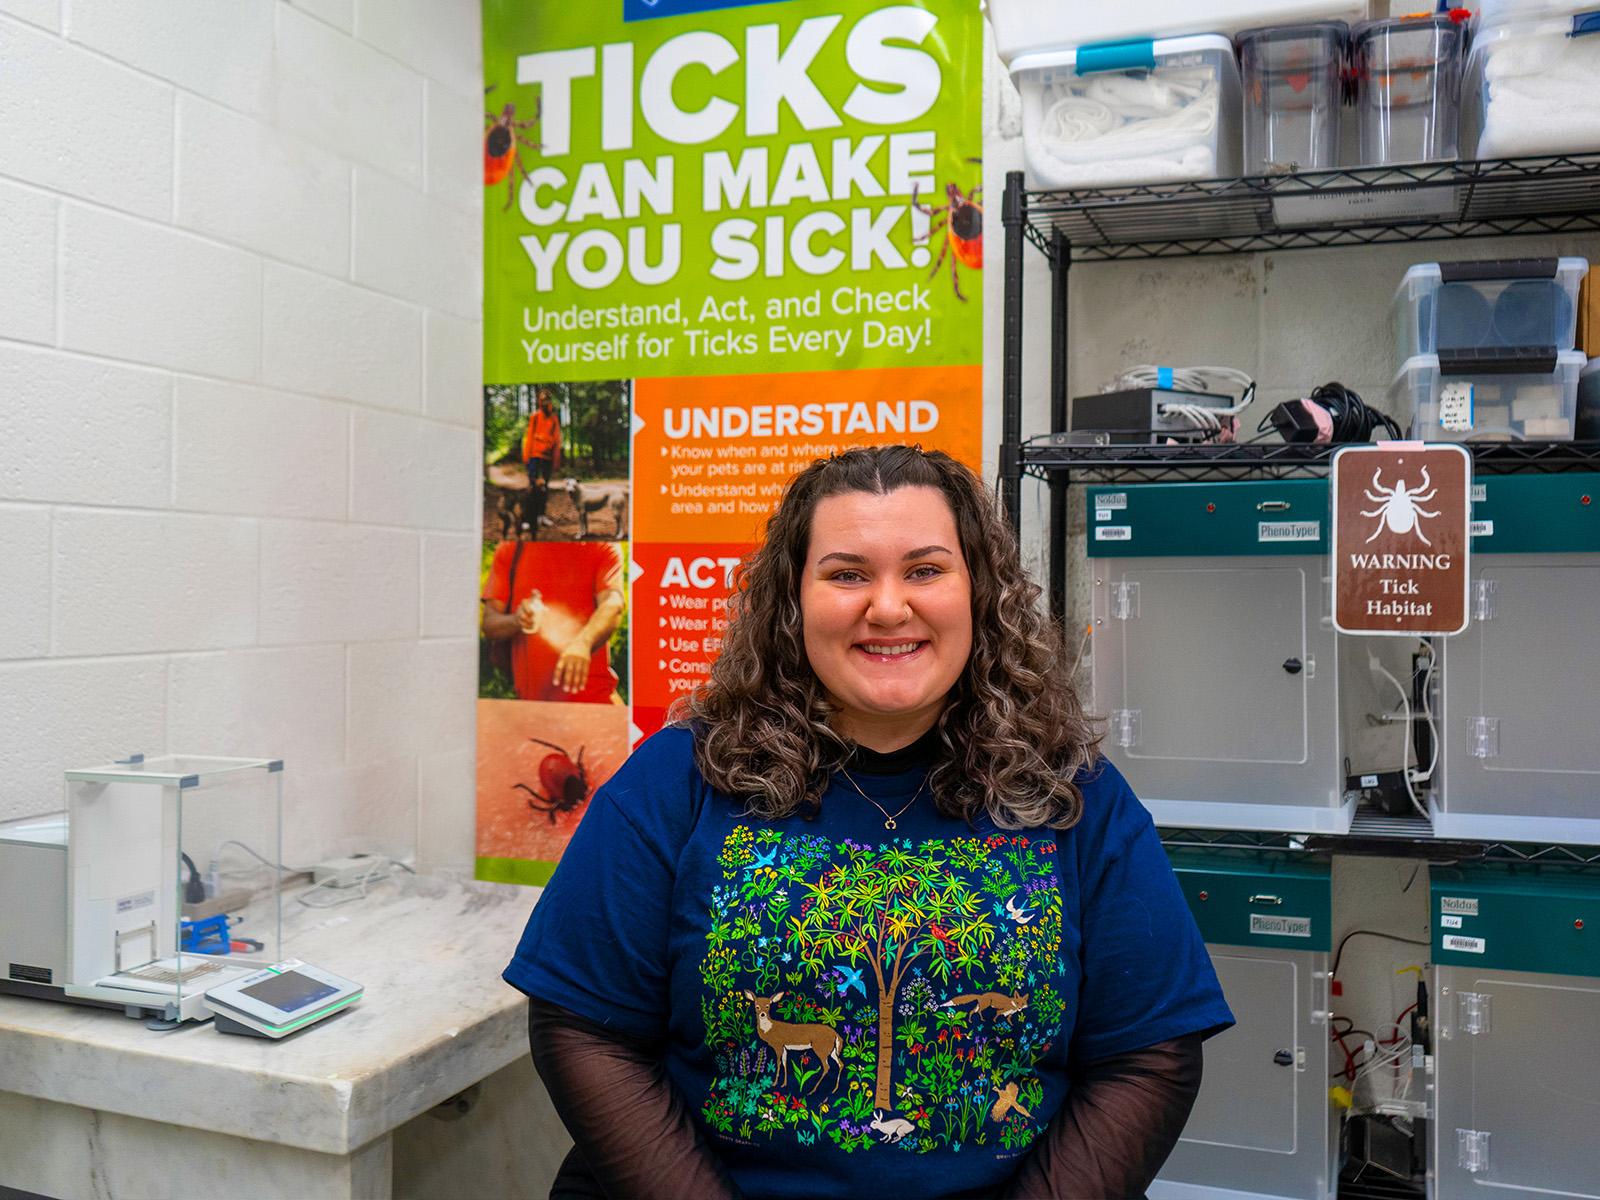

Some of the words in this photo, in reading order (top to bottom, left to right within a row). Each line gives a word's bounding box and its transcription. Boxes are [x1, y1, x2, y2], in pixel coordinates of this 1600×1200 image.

[516, 5, 942, 157] TICKS
[518, 156, 674, 226] CAN
[703, 131, 936, 211] MAKE
[519, 223, 681, 292] YOU
[709, 204, 932, 281] SICK!
[523, 297, 689, 332] Understand,
[698, 295, 755, 324] Act,
[766, 289, 820, 319] and
[831, 283, 931, 315] Check
[521, 334, 630, 364] Yourself
[636, 332, 674, 358] for
[683, 328, 758, 356] Ticks
[769, 326, 852, 356] Every
[863, 318, 931, 353] Day!
[663, 400, 939, 439] UNDERSTAND
[671, 446, 713, 458] Know
[717, 444, 756, 458] when
[761, 443, 788, 458] and
[671, 463, 703, 480] your
[707, 462, 739, 479] pets
[744, 463, 767, 475] are
[771, 461, 785, 474] at
[671, 482, 756, 497] Understand
[671, 502, 703, 514] area
[707, 500, 735, 514] and
[739, 499, 769, 513] how
[1261, 524, 1318, 538] PhenoTyper
[1350, 554, 1451, 570] WARNING
[659, 556, 741, 589] ACT
[1379, 579, 1419, 594] Tick
[669, 594, 708, 609] Wear
[1366, 600, 1433, 616] Habitat
[669, 615, 709, 630] Wear
[669, 637, 699, 652] Use
[1252, 916, 1309, 934] PhenoTyper
